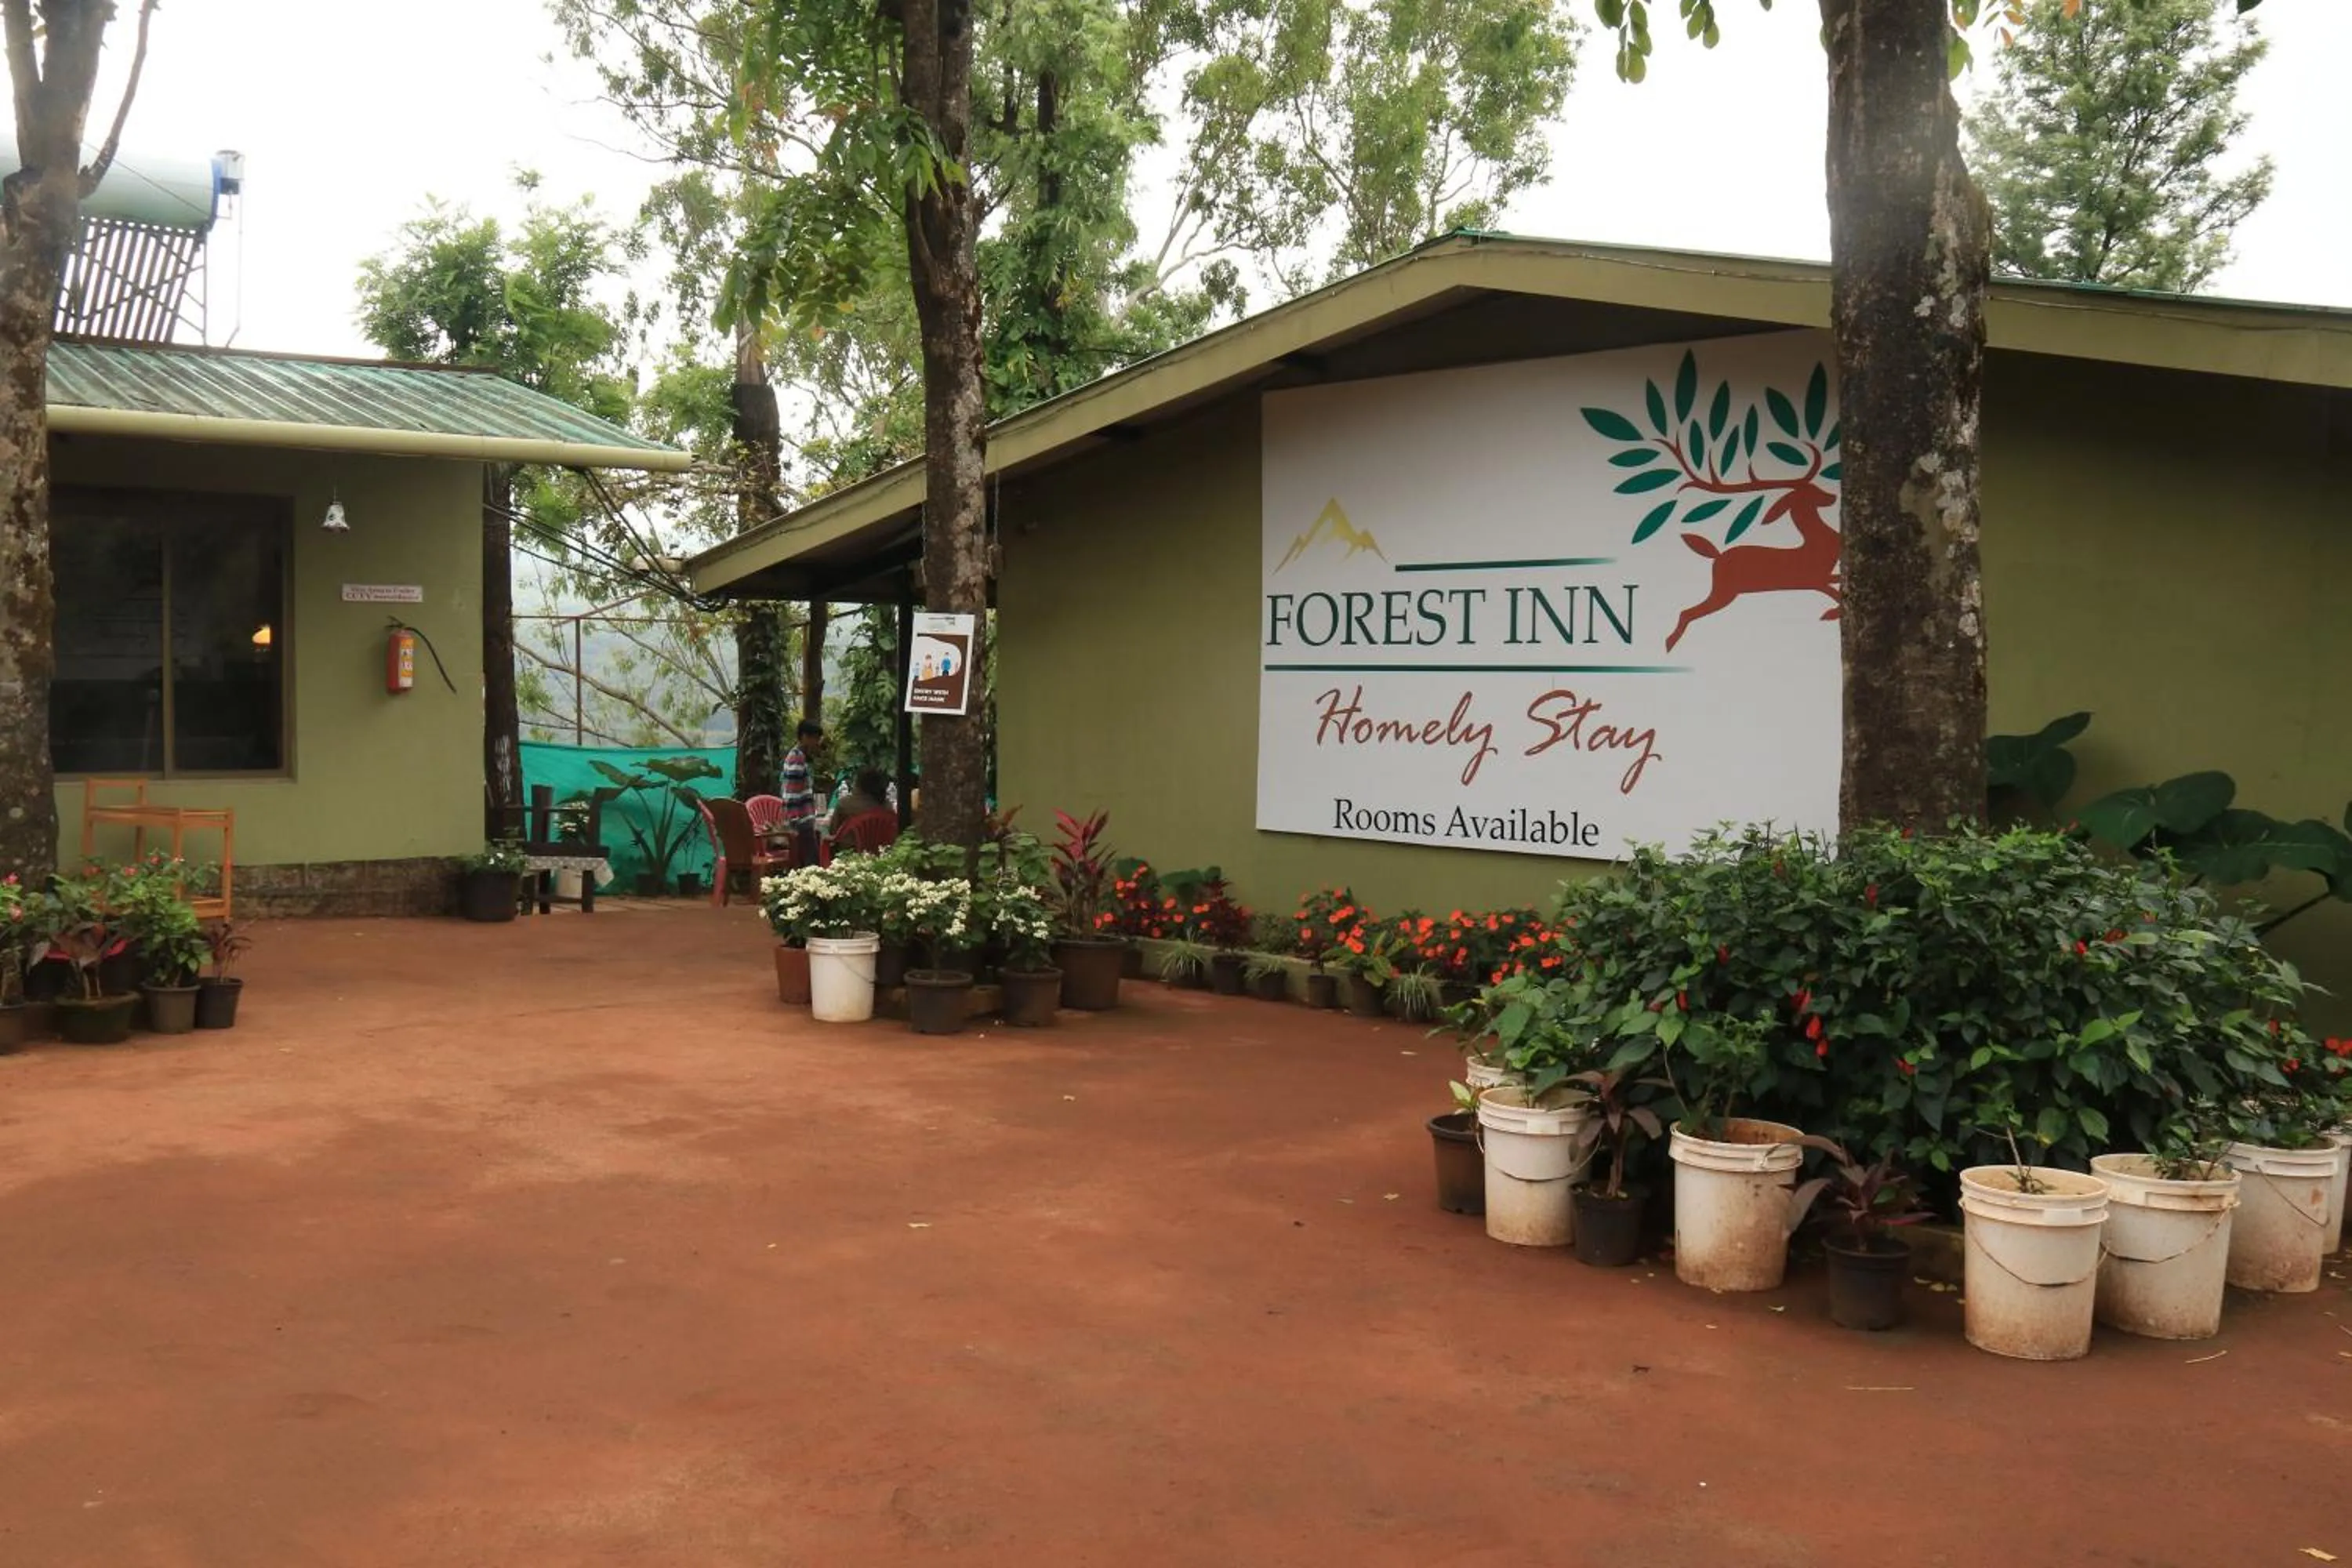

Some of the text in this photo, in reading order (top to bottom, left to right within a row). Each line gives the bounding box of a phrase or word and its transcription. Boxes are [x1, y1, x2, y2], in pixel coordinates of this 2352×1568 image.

[1265, 585, 1639, 646] FOREST INN
[1315, 684, 1663, 795] Homely Stay
[1334, 798, 1599, 848] Rooms Available
